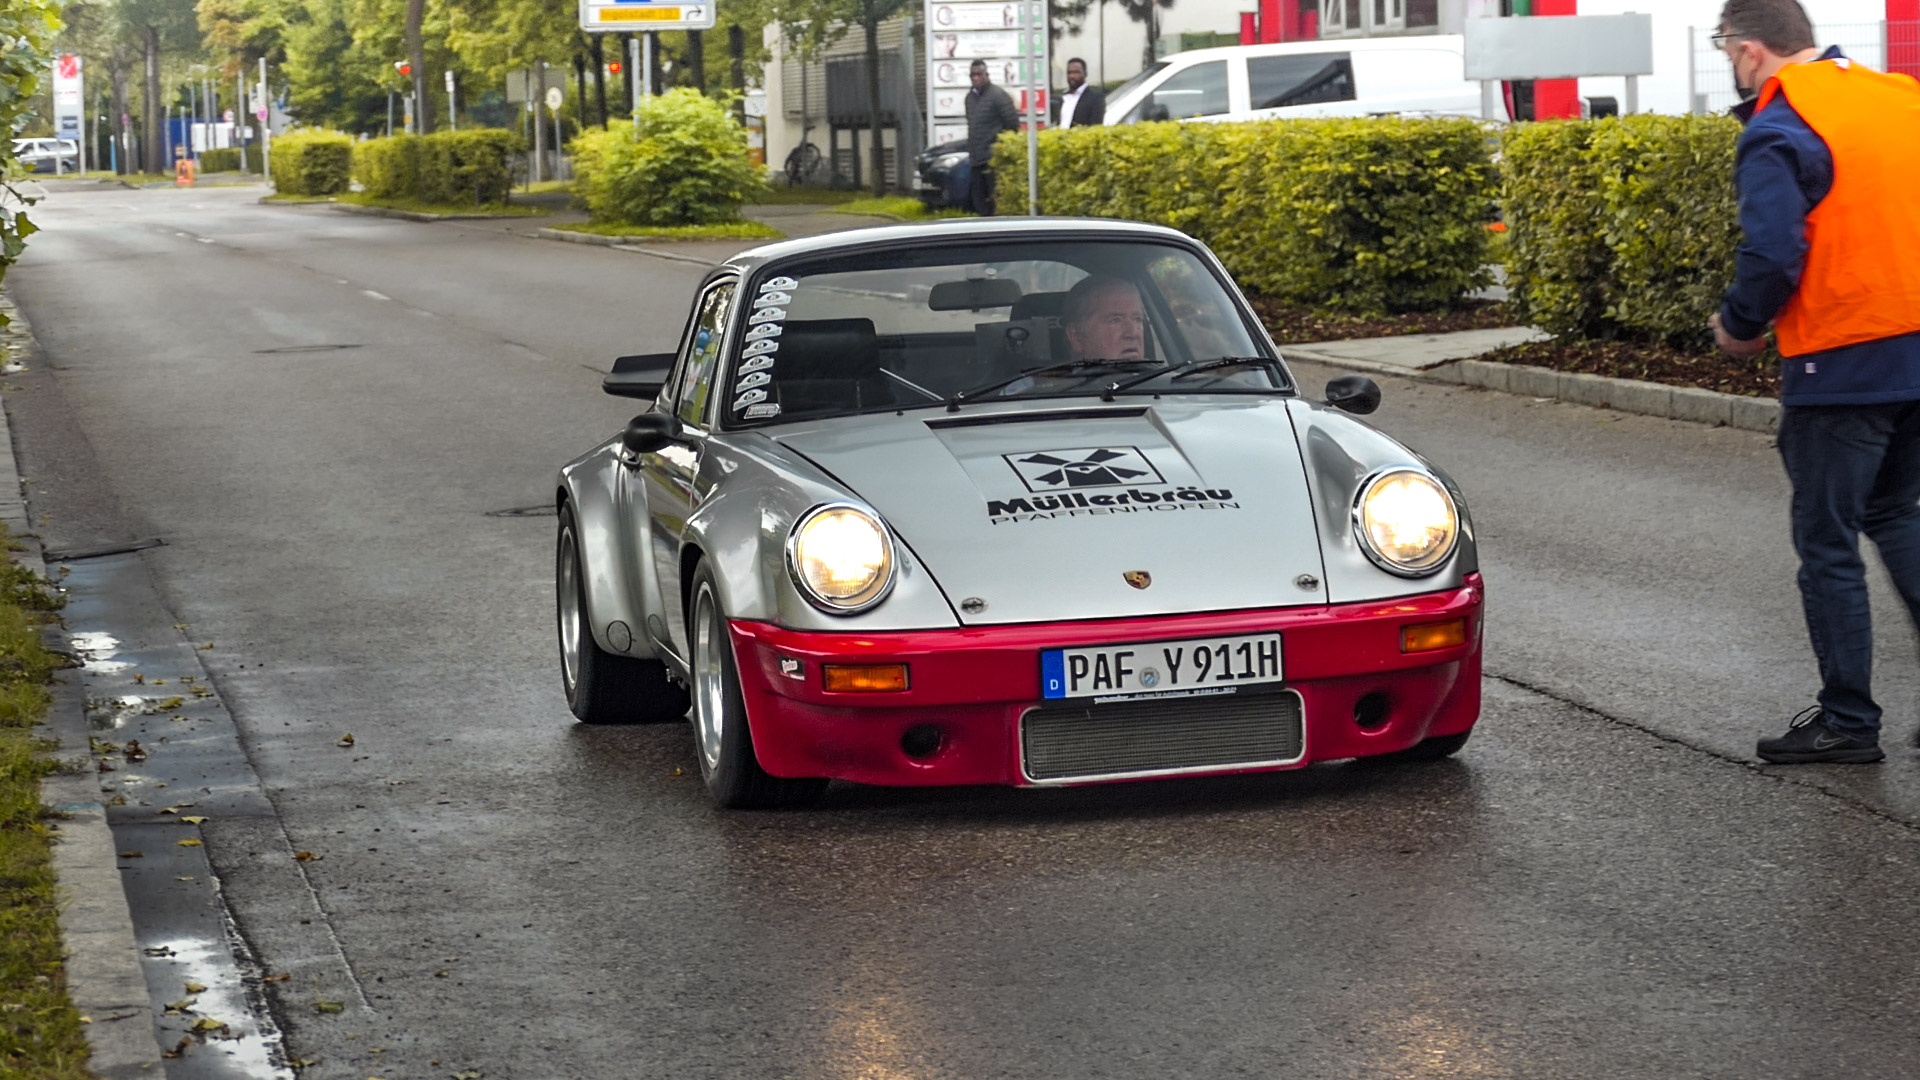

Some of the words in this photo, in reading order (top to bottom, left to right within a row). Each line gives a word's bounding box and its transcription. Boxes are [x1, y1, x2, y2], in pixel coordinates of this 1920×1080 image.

[987, 486, 1233, 516] Müllerbräu
[991, 502, 1240, 525] PFAFFENHOFEN
[1068, 651, 1134, 691] PAF
[1050, 679, 1059, 690] D
